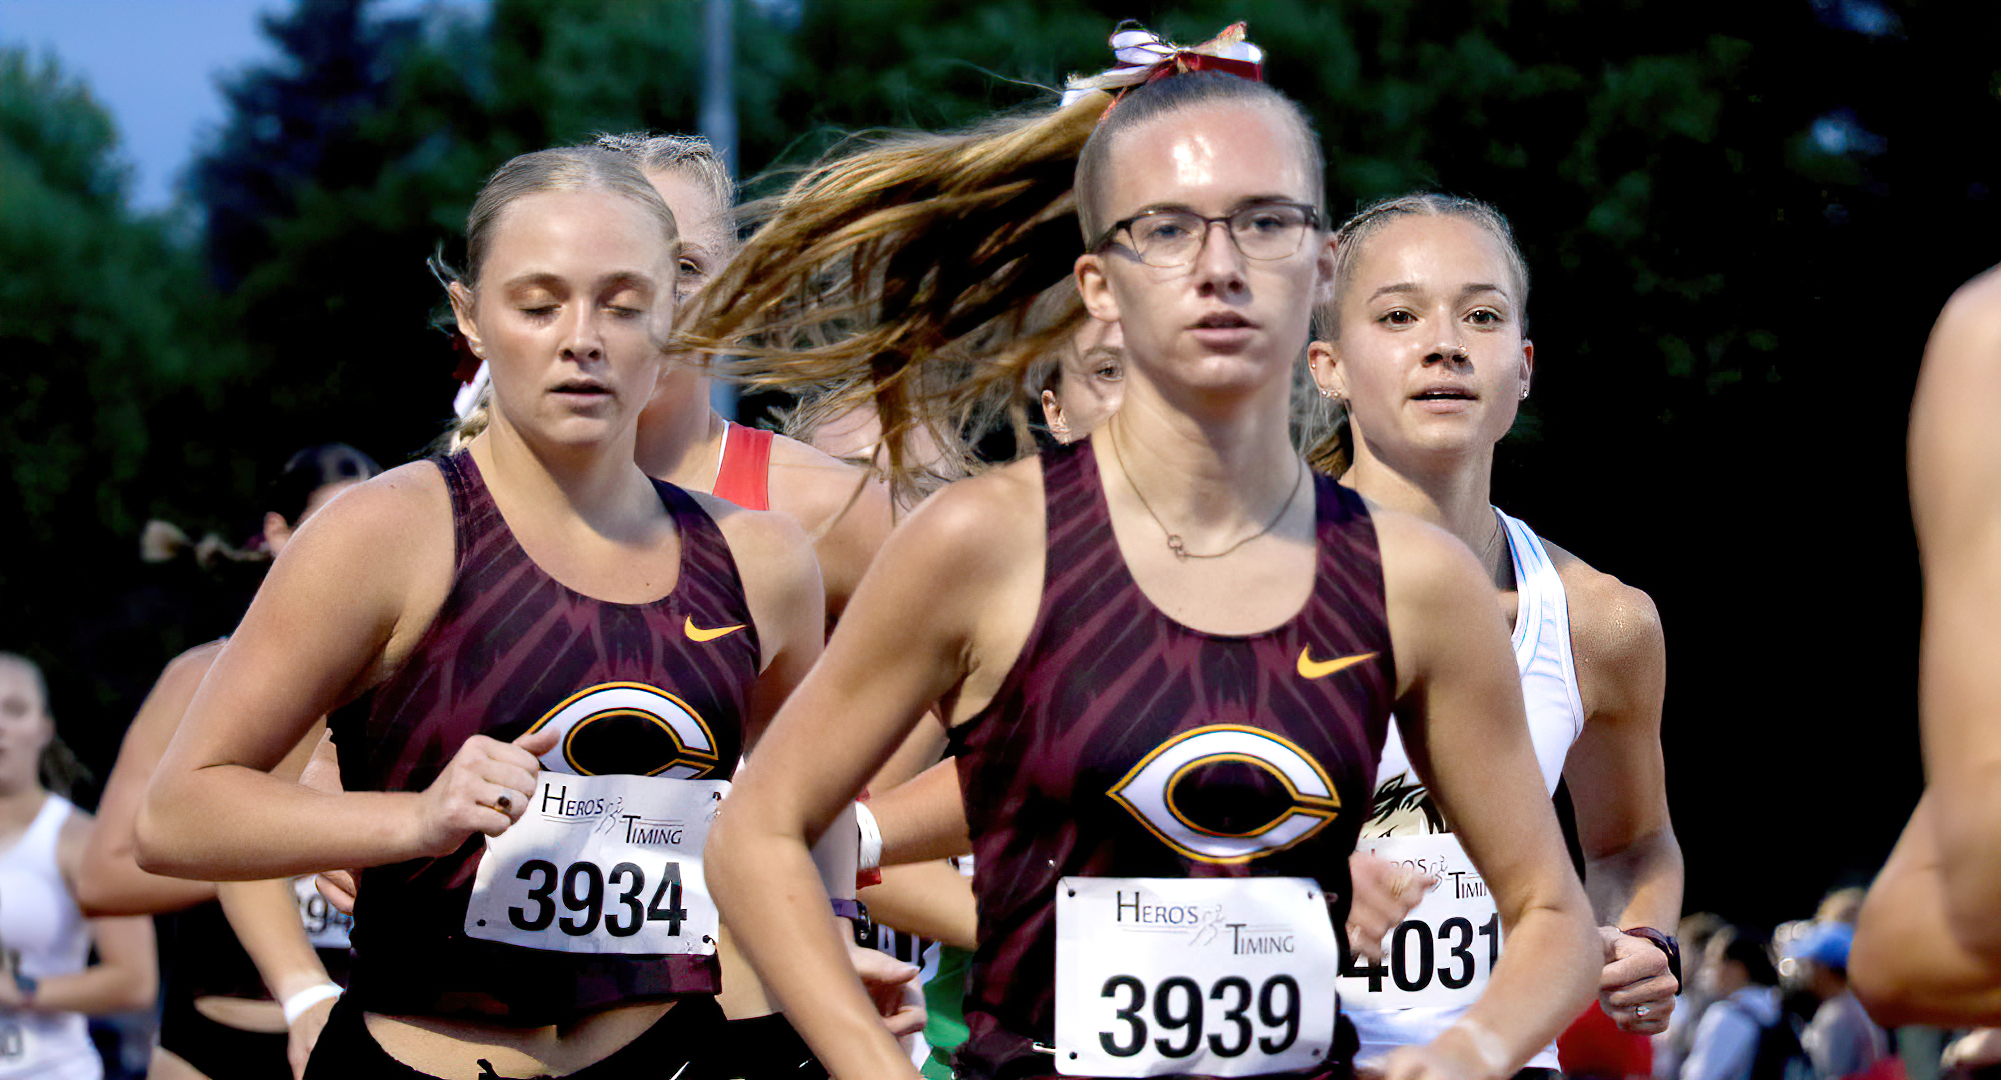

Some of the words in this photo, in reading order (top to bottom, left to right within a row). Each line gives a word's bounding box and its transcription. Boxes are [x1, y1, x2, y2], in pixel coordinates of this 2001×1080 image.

[622, 815, 683, 845] TIMING
[508, 859, 687, 937] 3934
[1116, 891, 1199, 925] HERO'S
[1225, 924, 1295, 956] TIMING
[1098, 974, 1301, 1058] 3939
